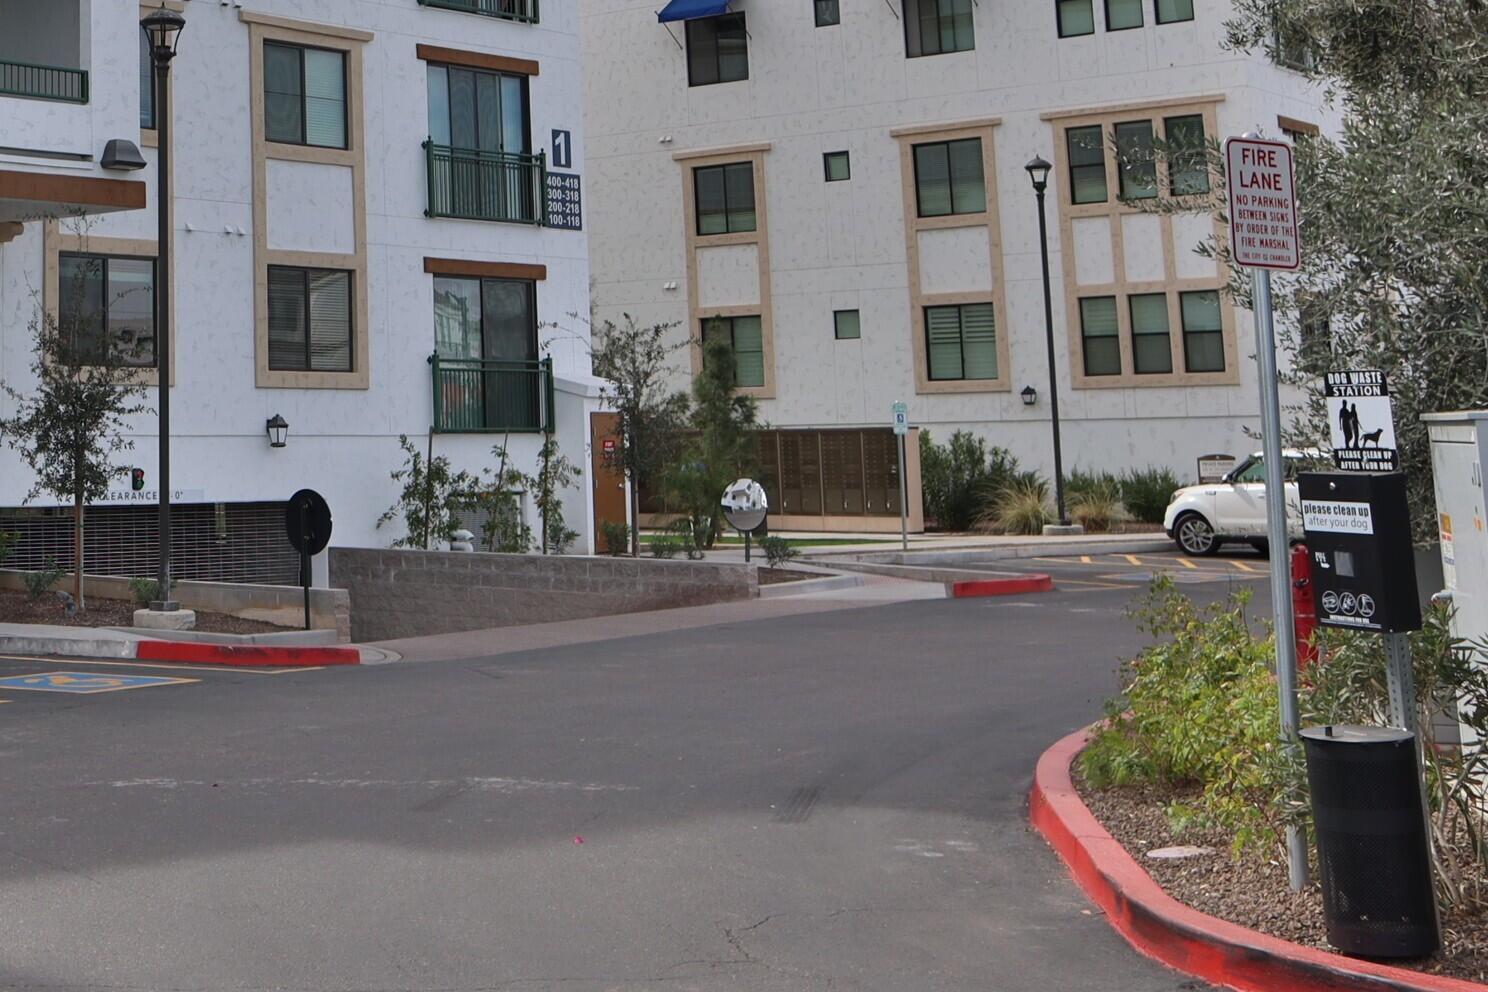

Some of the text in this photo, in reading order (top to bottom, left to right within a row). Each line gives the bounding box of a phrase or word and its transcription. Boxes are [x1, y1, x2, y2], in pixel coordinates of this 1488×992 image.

[554, 132, 566, 165] 1
[1242, 148, 1277, 168] FIRE
[546, 176, 578, 189] 400-418
[1240, 170, 1282, 191] LANE
[547, 189, 579, 202] 300-318
[1236, 194, 1289, 210] NO PARKING
[548, 202, 580, 214] 200-218
[549, 214, 580, 227] 100-118
[1238, 209, 1289, 223] BETWEEN SIGNS
[1236, 223, 1293, 237] BY ORDER OF THE
[1241, 236, 1290, 250] FIRE MARSHAL
[1328, 372, 1382, 385] DOG WASTE
[1333, 386, 1381, 396] STATION
[1338, 450, 1392, 459] PLEASE CLEAN UP
[1341, 461, 1393, 470] AFTER YOUR DOG
[1304, 503, 1369, 517] please clean up
[1308, 516, 1368, 530] after your dog
